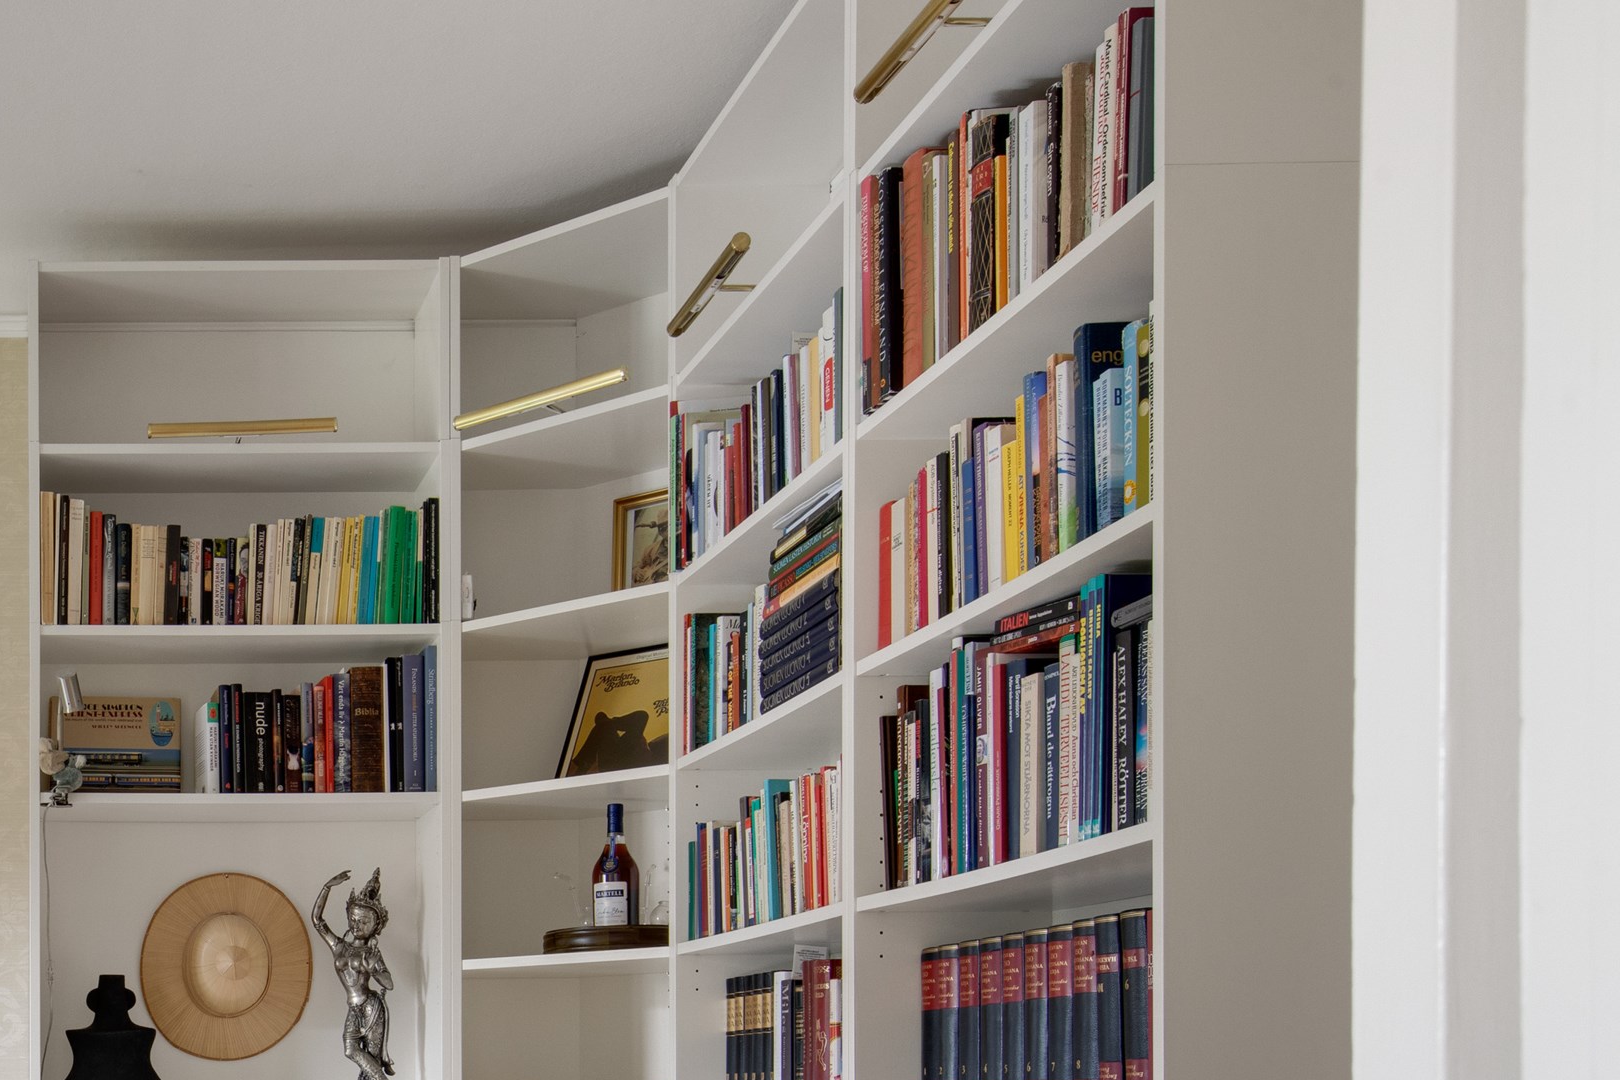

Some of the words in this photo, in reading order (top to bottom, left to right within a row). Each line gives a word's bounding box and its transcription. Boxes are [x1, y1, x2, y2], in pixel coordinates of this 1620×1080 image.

[1104, 39, 1113, 71] Marie
[1102, 71, 1111, 117] Cardinal
[1047, 142, 1056, 164] Sin
[1101, 124, 1110, 159] Orden
[1045, 164, 1055, 197] egen
[1099, 181, 1109, 219] befriar
[1101, 378, 1109, 430] BORKMANN'S
[1123, 364, 1134, 467] SOLTECKEN
[1101, 430, 1109, 452] POINT
[1101, 456, 1111, 481] HÅKAN
[1101, 481, 1109, 511] NESSER
[1007, 518, 1013, 527] 22
[257, 531, 266, 566] TIKKANEN
[255, 571, 265, 602] 30-ÅRIGA
[1000, 612, 1030, 632] ITALIEN
[596, 673, 634, 688] Marlon
[727, 670, 734, 682] OF
[1059, 652, 1071, 709] LAIHDU
[1117, 645, 1127, 688] ALEX
[338, 680, 346, 695] Vårt
[427, 668, 436, 705] Strindberg
[604, 677, 640, 693] Brando
[101, 703, 144, 711] SIMPLON
[255, 701, 268, 736] nude
[338, 695, 346, 710] enda
[338, 711, 346, 719] liv
[354, 706, 380, 718] Biblia
[1023, 699, 1032, 731] SIKTA
[1046, 695, 1057, 739] Bland
[1117, 690, 1127, 745] HALEY
[338, 726, 346, 747] Martin
[1023, 732, 1032, 758] MOT
[1046, 742, 1054, 759] de
[1071, 734, 1079, 761] Anna
[257, 737, 266, 772] photography
[336, 748, 347, 777] Hägglund
[931, 722, 941, 792] italienskt
[1071, 761, 1079, 777] och
[1044, 761, 1055, 819] rättrogna
[1059, 714, 1071, 838] TERVEELLISESTI
[1117, 757, 1129, 825] RÖTTER
[1140, 765, 1148, 809] NORMAN
[1022, 759, 1034, 835] STJÄRNORNA
[1071, 777, 1079, 820] Christian
